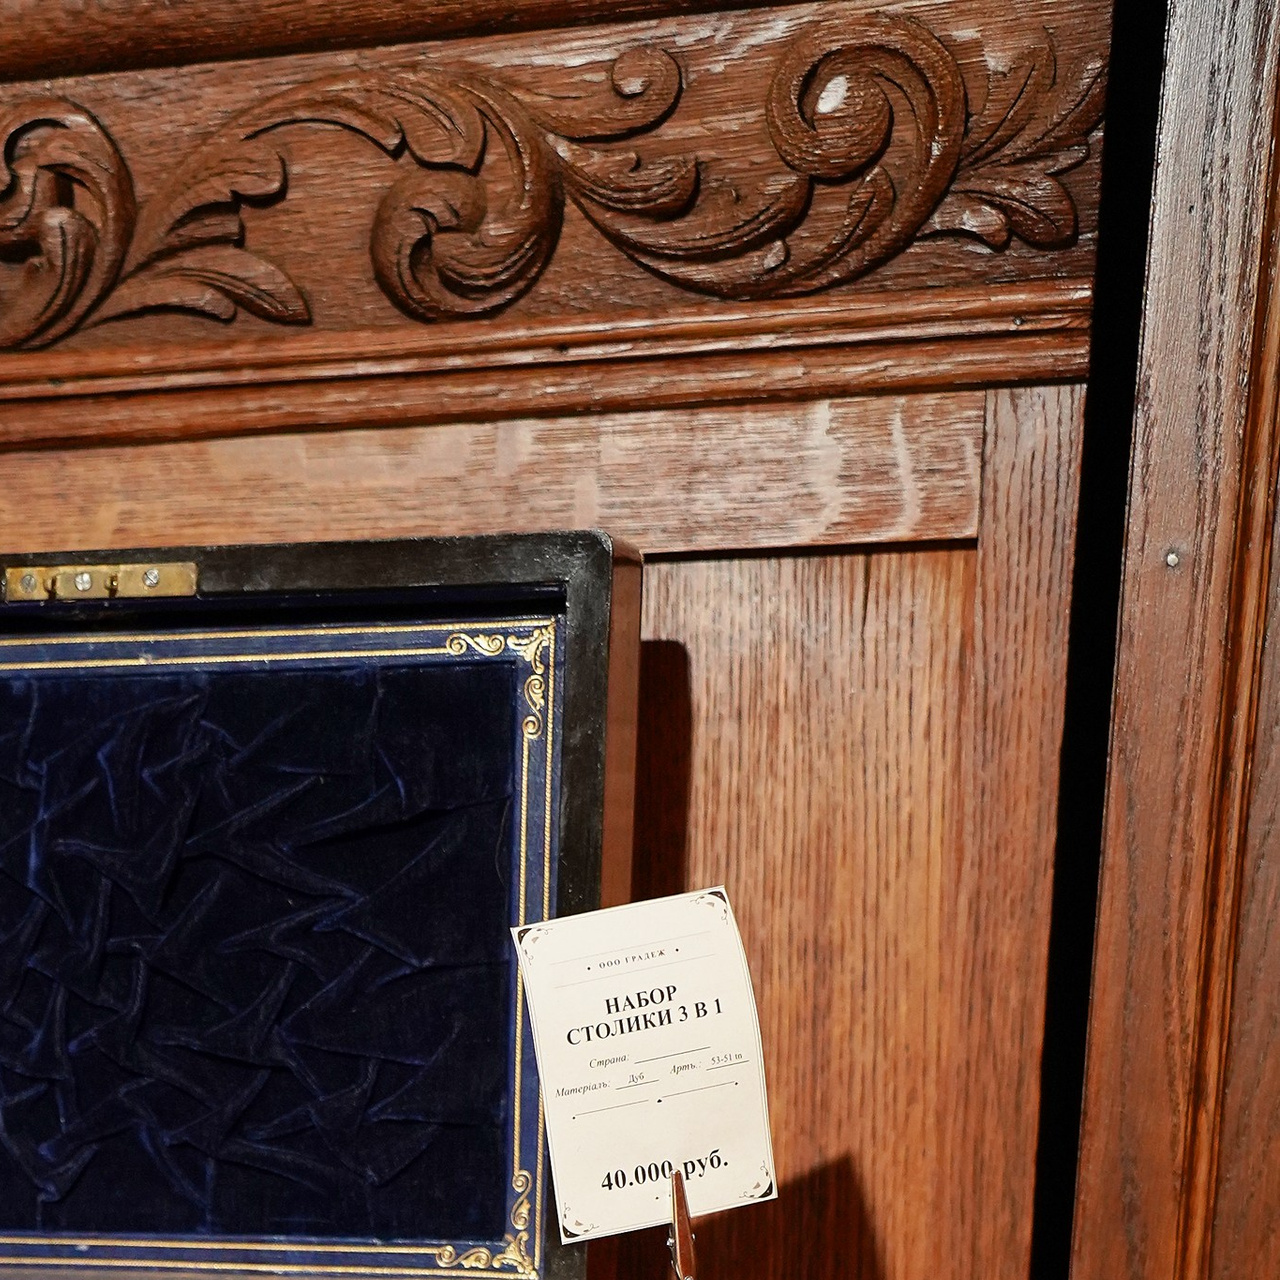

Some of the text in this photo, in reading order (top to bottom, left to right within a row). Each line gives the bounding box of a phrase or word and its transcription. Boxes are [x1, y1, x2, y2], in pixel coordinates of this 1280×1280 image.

[605, 985, 677, 1014] НАБОР
[566, 998, 723, 1045] СТОЛИКИ 3 В 1
[589, 1054, 630, 1069] Страна:
[628, 1072, 645, 1084] Дуб
[601, 1149, 729, 1191] 40.000 руб.
